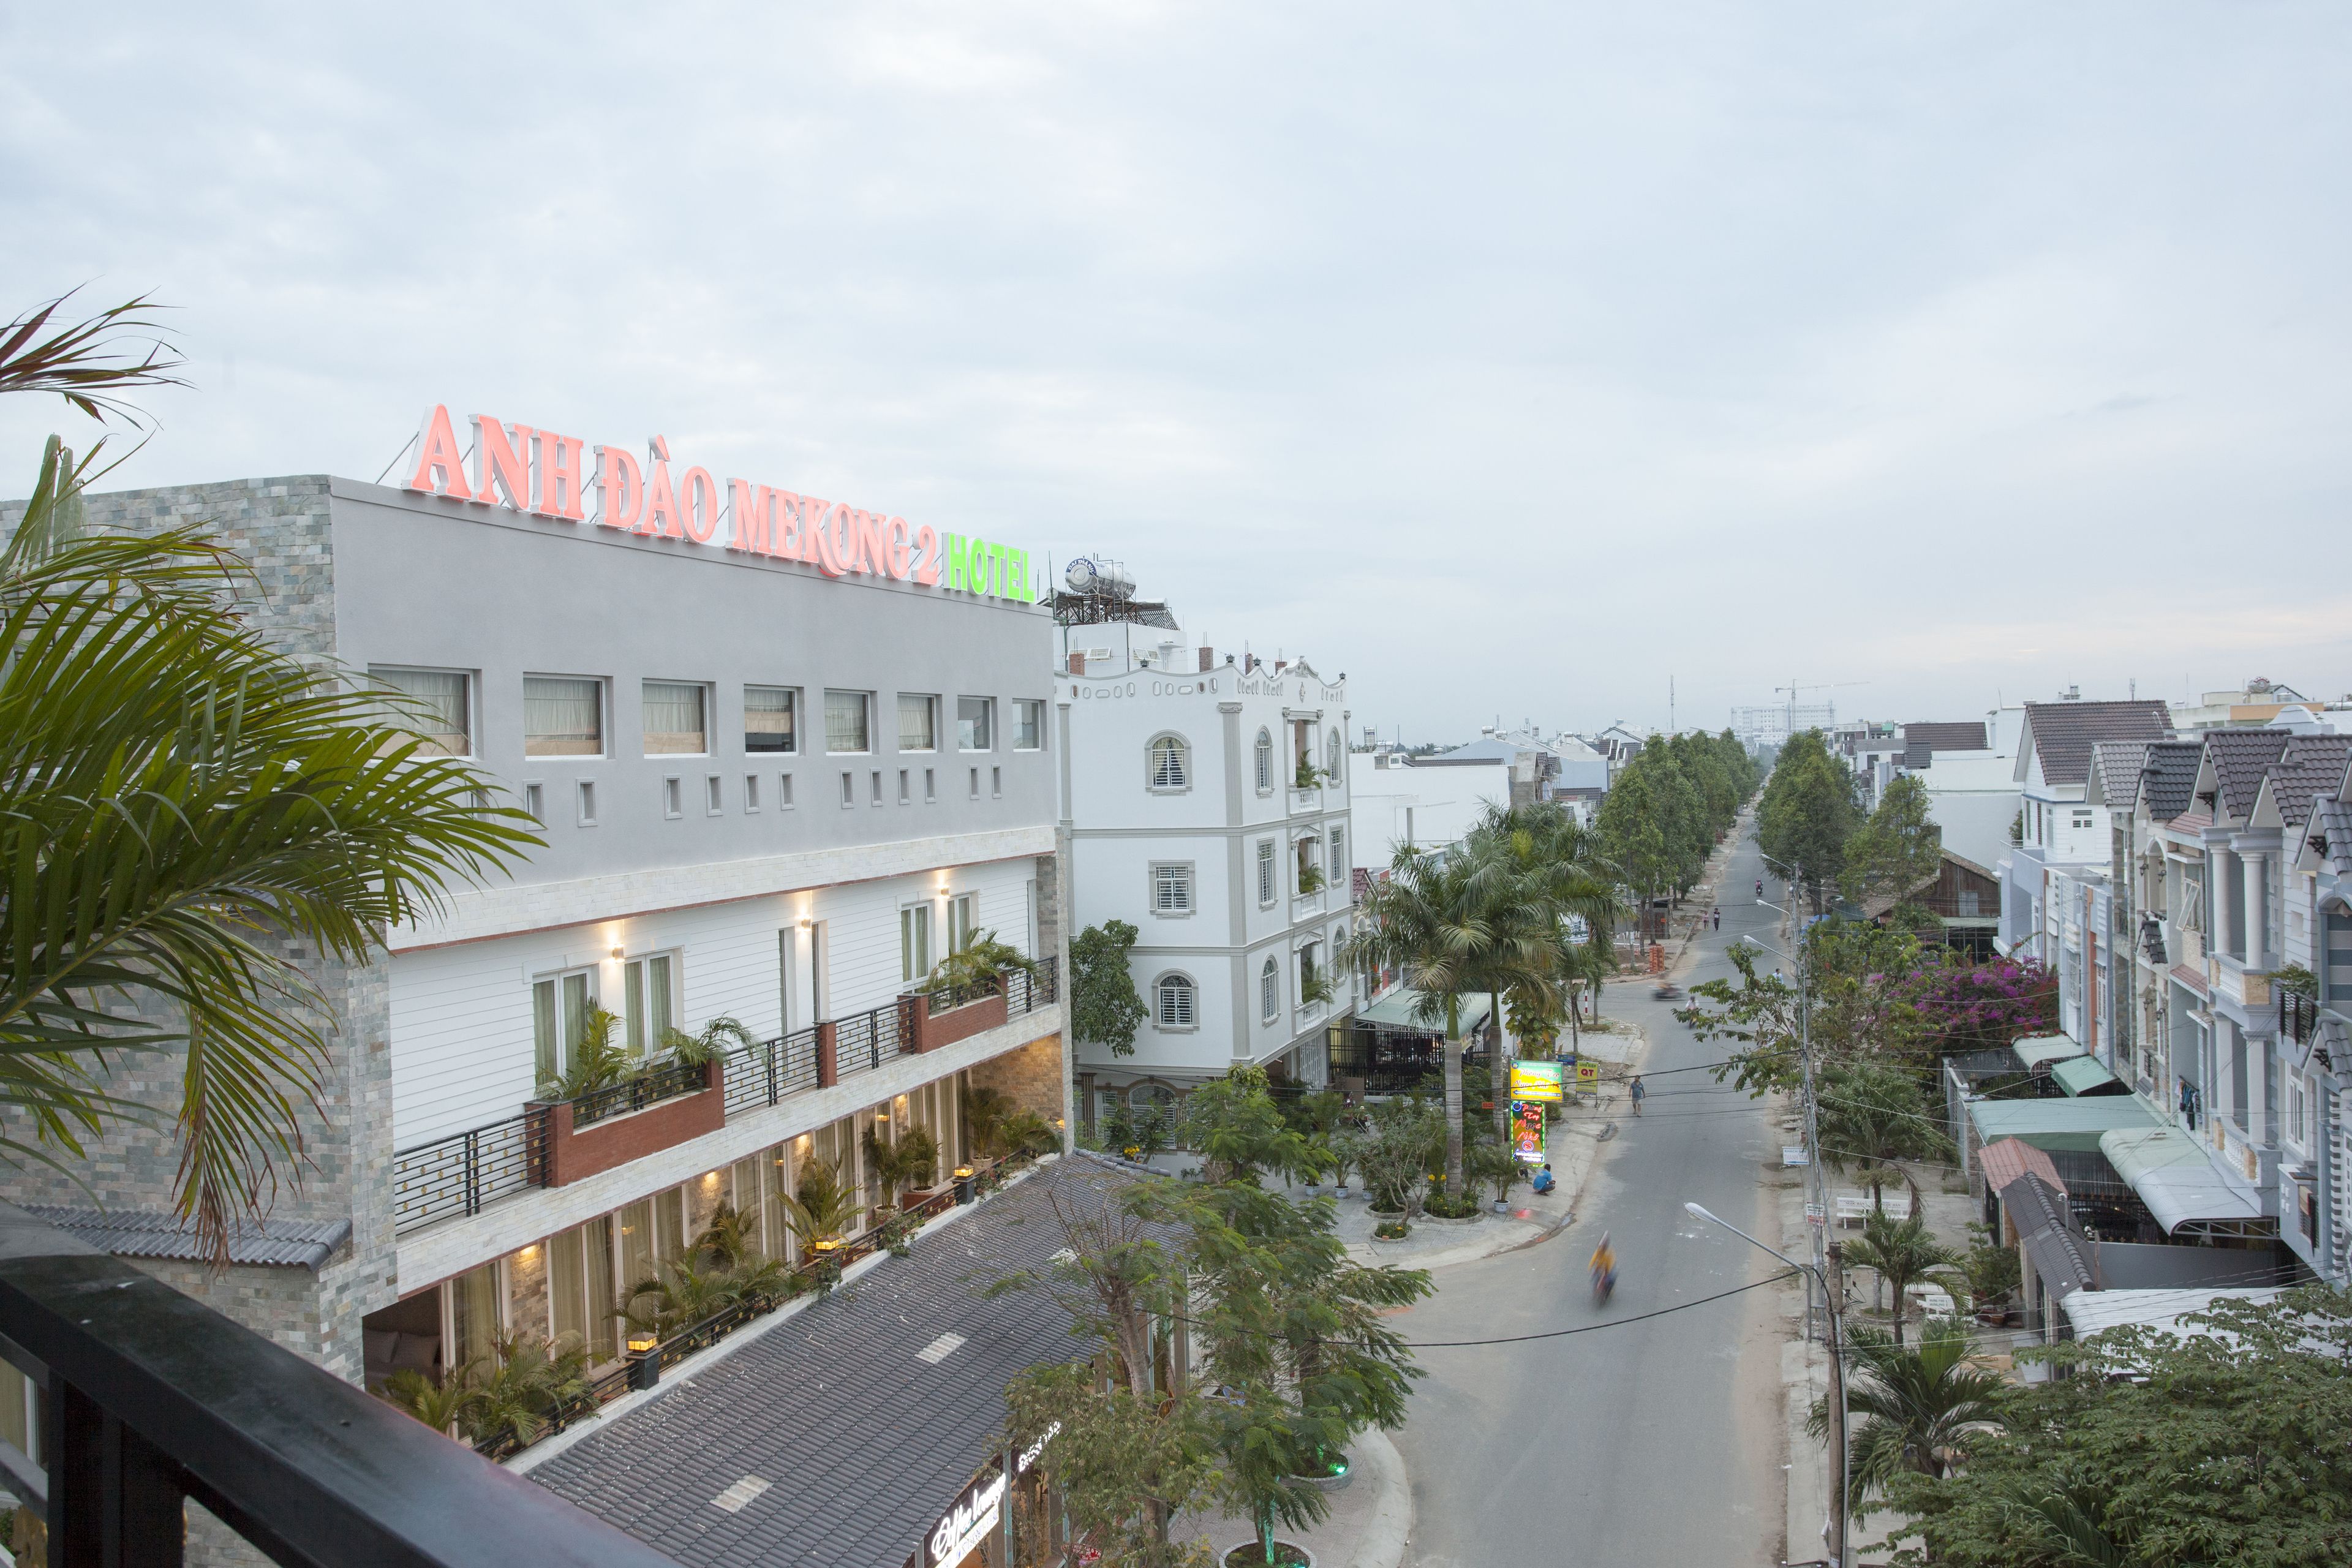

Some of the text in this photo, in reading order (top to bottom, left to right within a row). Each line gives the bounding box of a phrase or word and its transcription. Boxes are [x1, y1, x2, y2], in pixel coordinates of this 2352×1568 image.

[402, 404, 1035, 603] ANH ĐÀO MEKONG 2 HOTEL
[1581, 1068, 1594, 1077] QT
